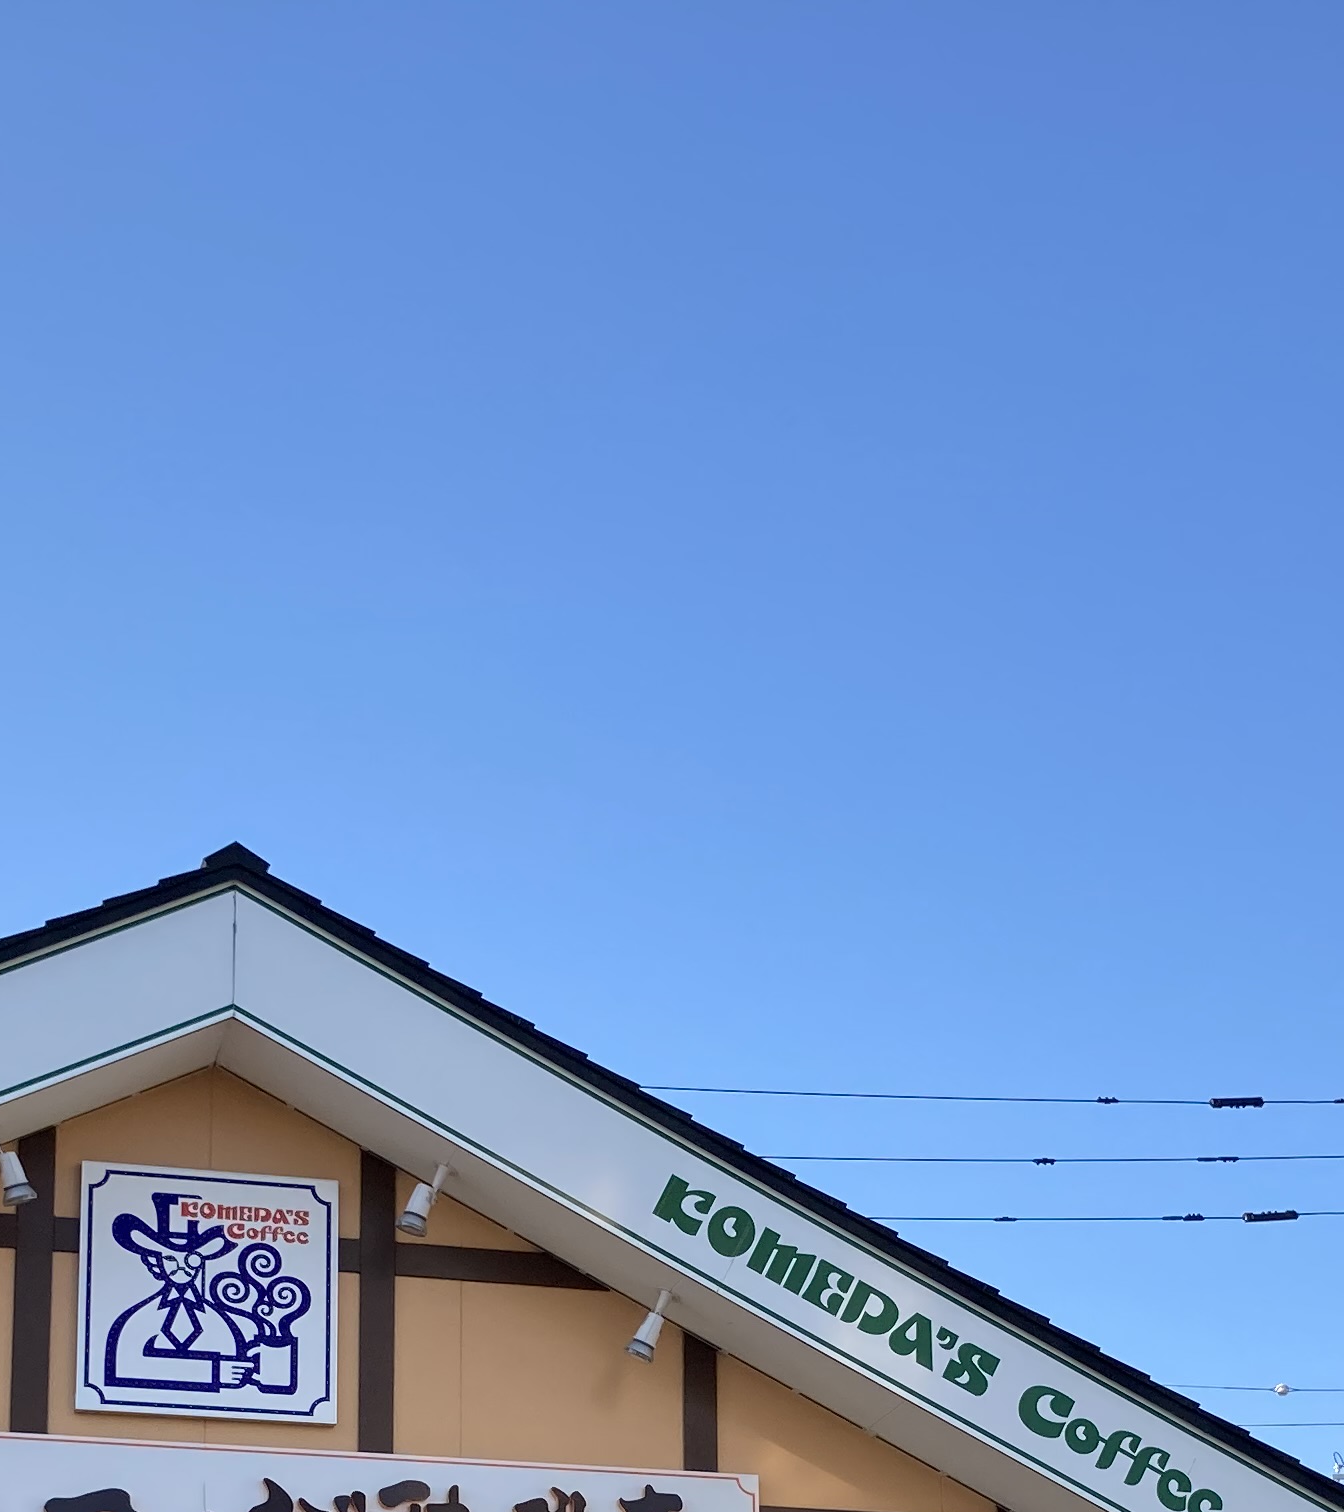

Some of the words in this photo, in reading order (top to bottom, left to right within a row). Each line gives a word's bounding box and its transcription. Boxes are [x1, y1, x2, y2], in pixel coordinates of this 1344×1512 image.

[181, 1201, 310, 1226] KOMEDA'S
[227, 1222, 310, 1244] Coffee
[652, 1174, 1001, 1396] KOMEDA'S
